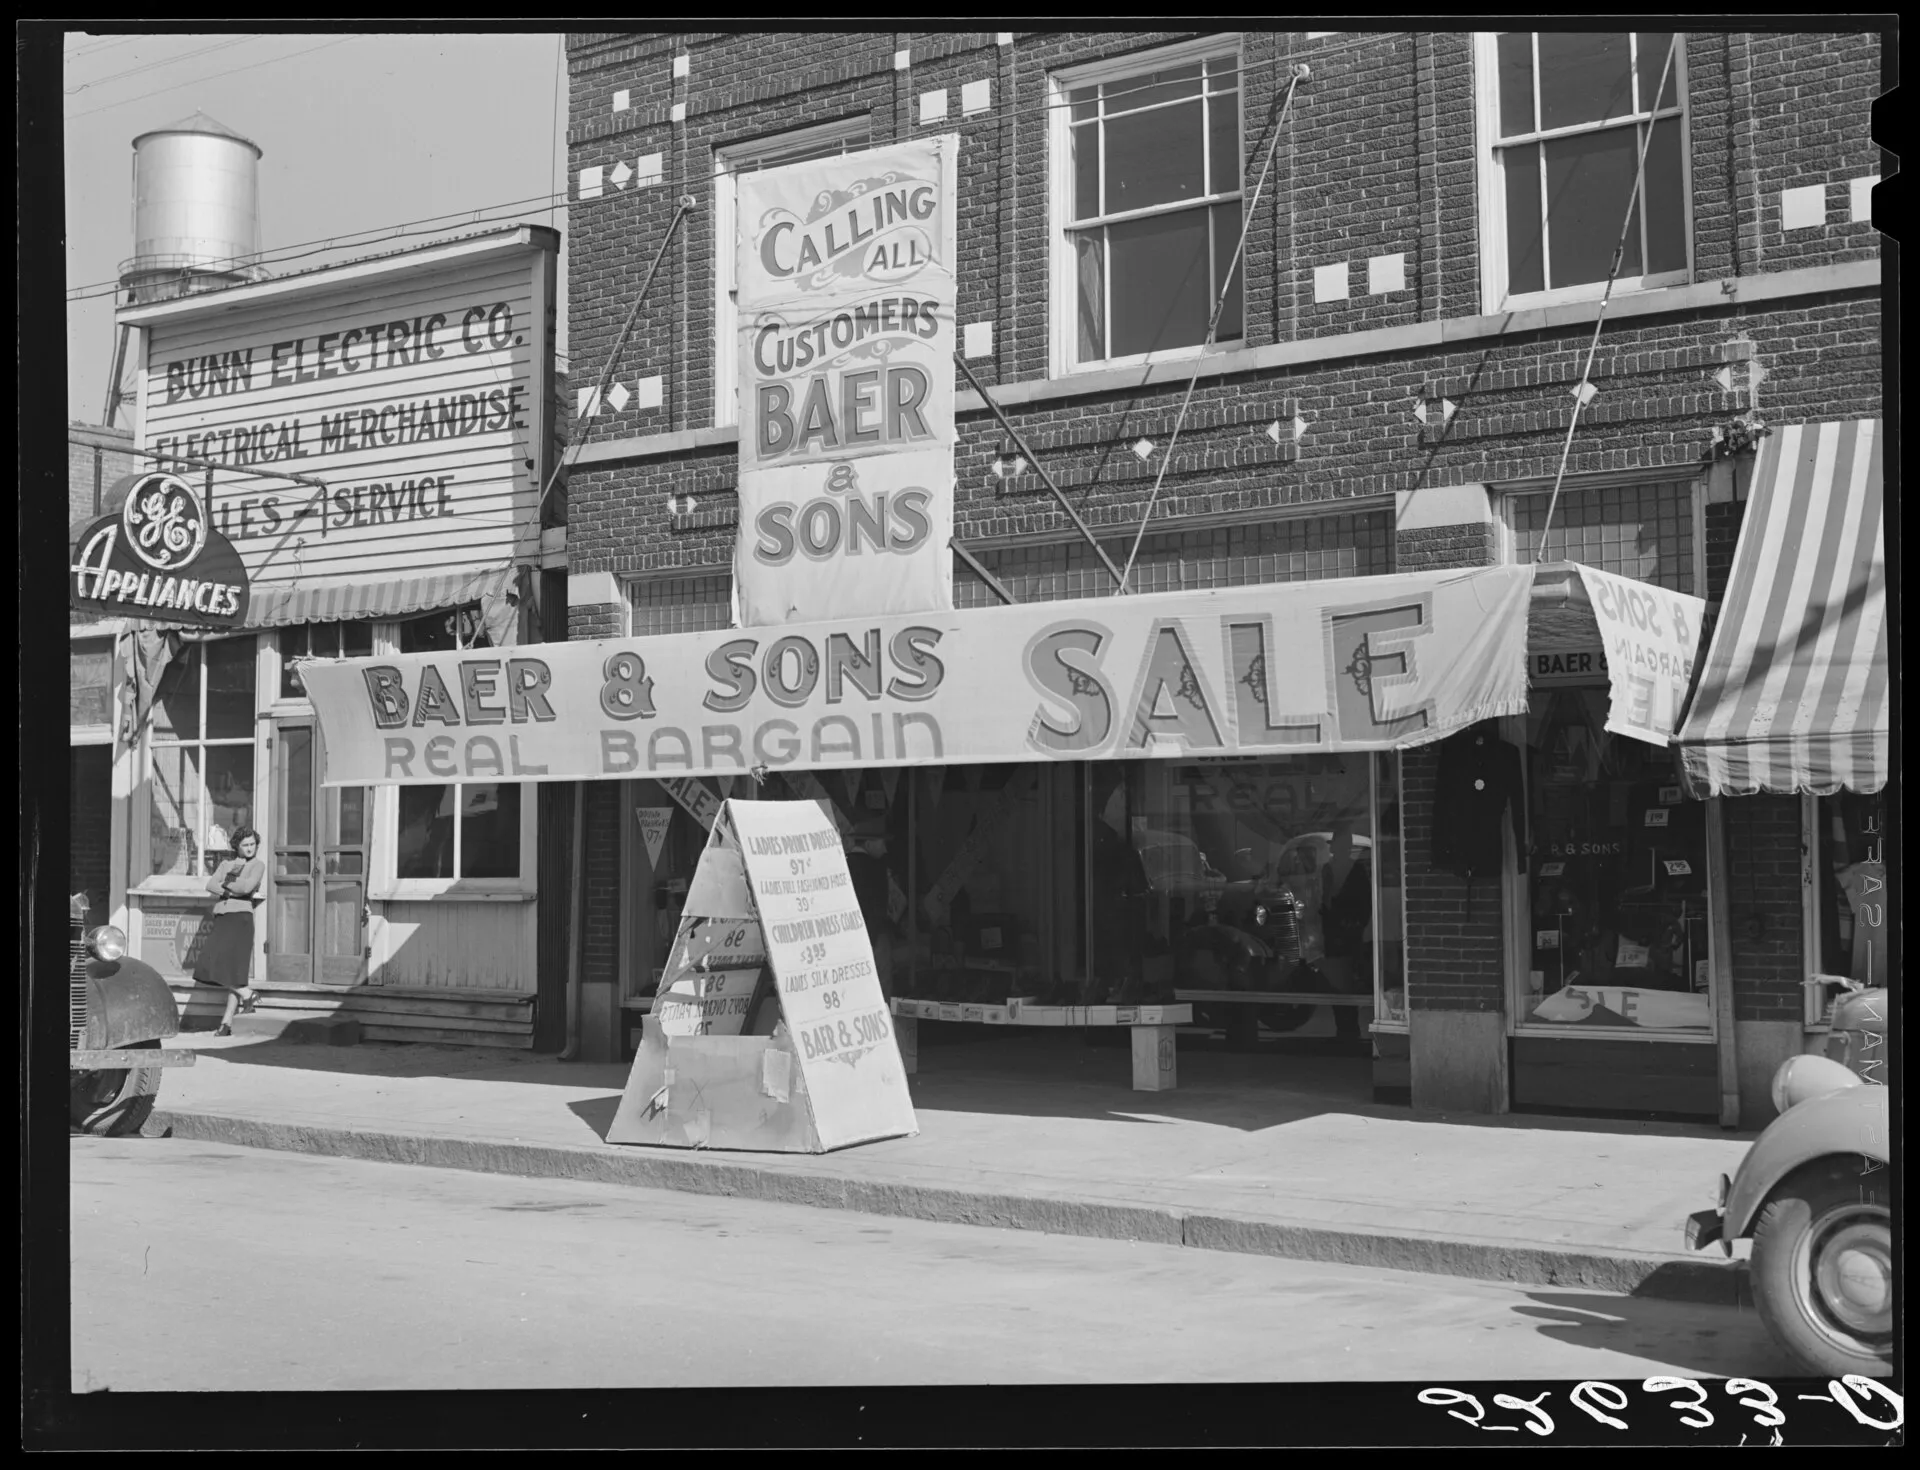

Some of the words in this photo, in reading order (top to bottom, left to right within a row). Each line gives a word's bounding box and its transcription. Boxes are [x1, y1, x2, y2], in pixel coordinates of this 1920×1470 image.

[760, 186, 936, 277] CALLING
[866, 239, 925, 271] ALL
[165, 348, 253, 404] BUNN
[270, 312, 447, 388] ELECTRIC
[461, 302, 524, 354] CO.
[754, 298, 940, 377] CUSTOMERS
[155, 418, 309, 474] ELECTRICAL
[321, 385, 525, 452] MERCHANDISE
[755, 363, 936, 461] BAER
[210, 496, 281, 540] LES
[331, 474, 456, 528] SERVICE
[825, 462, 858, 494] &
[753, 487, 934, 568] SONS
[71, 524, 242, 617] APPLIANCES
[362, 657, 557, 729] BAER
[599, 652, 657, 720] &
[702, 626, 946, 713] SONS
[1021, 591, 1435, 760] SALE
[1537, 652, 1592, 674] BAER
[384, 733, 549, 779] REAL
[600, 711, 944, 773] BARGAIN
[748, 836, 783, 855] LADIES
[1580, 842, 1621, 856] SONS
[146, 928, 172, 936] SERVICE
[815, 914, 841, 938] DRESS
[785, 973, 808, 993] LADIES
[812, 969, 830, 988] SILK
[832, 960, 872, 985] DRESSES
[801, 1024, 838, 1059] BAER
[837, 1020, 853, 1048] &
[853, 1010, 889, 1046] SONS
